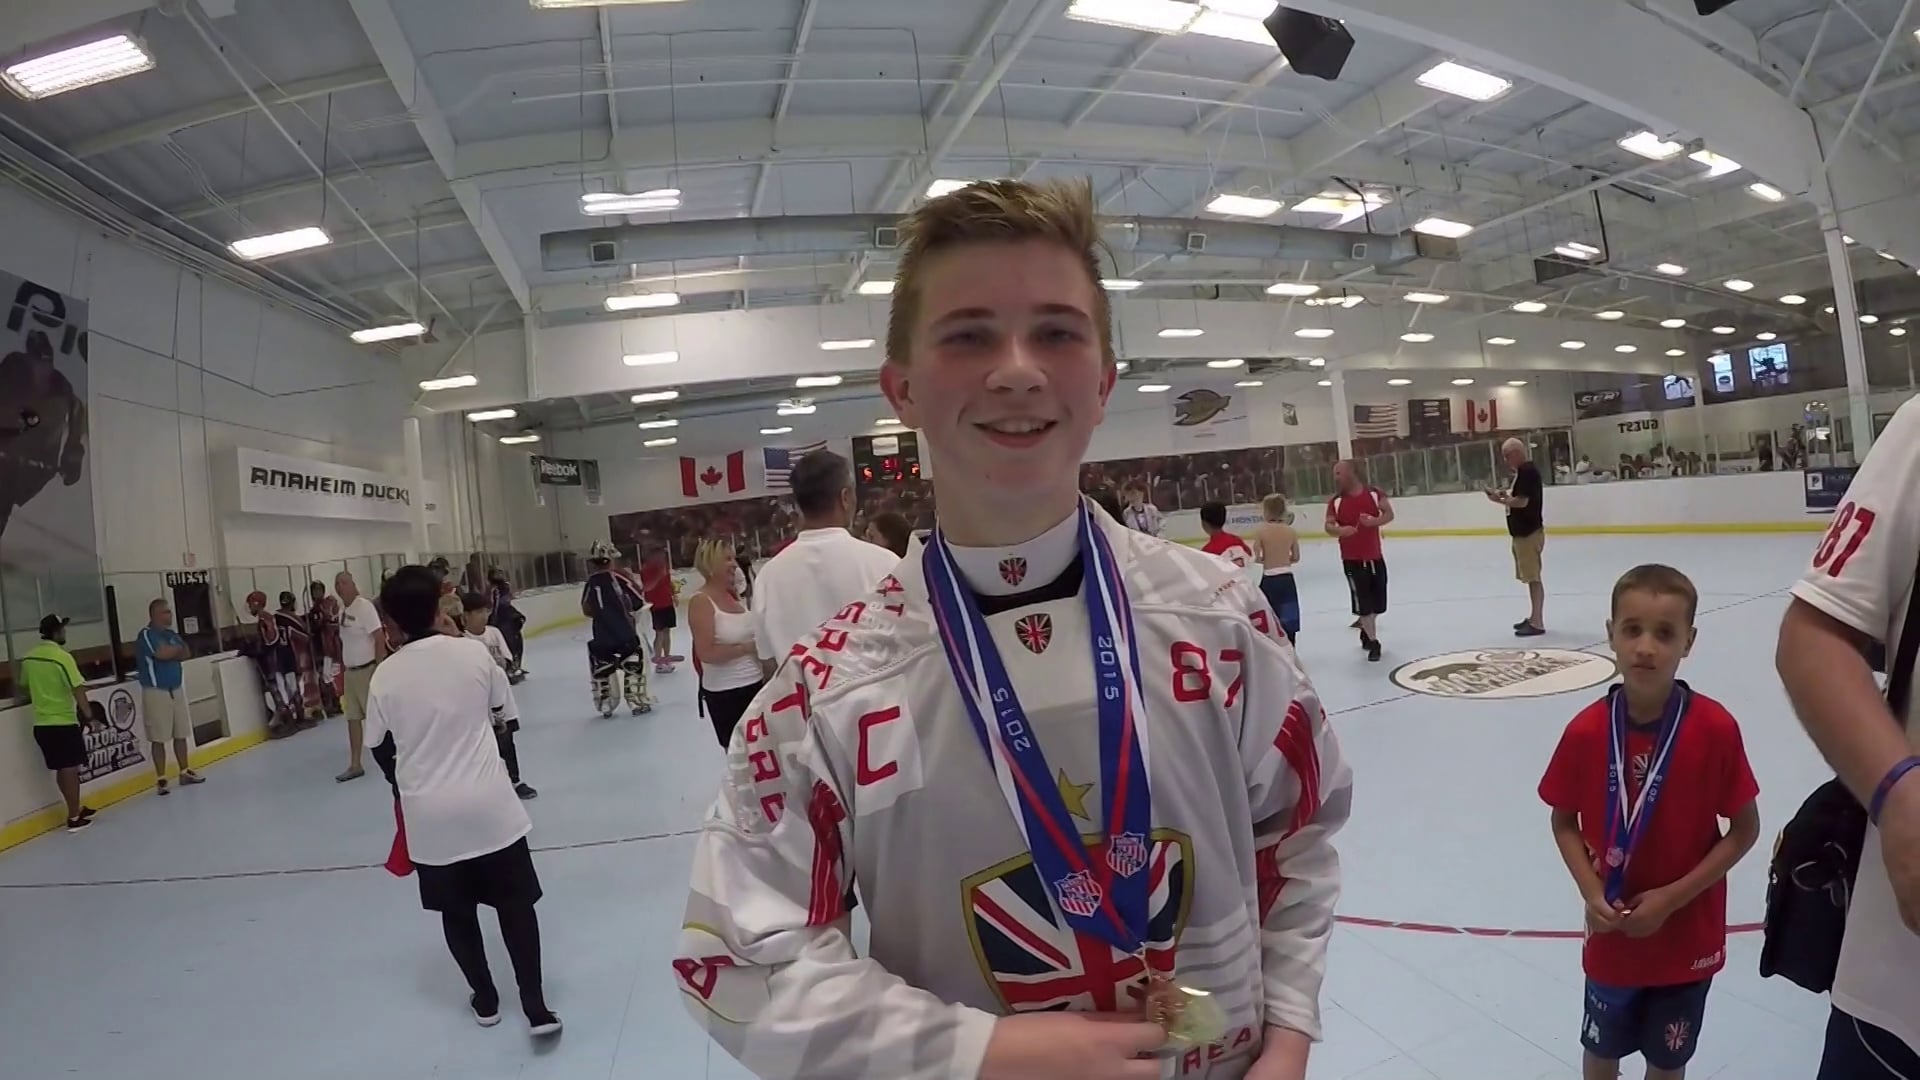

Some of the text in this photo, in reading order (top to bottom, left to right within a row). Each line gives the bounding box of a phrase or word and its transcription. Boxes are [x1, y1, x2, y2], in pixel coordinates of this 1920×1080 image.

[250, 466, 356, 497] ANAHEIM
[541, 459, 578, 476] Reebok
[1813, 501, 1876, 578] 87
[166, 571, 209, 588] GUEST
[1097, 635, 1120, 701] 2015
[1170, 640, 1244, 709] 87
[857, 705, 901, 786] C
[992, 687, 1032, 753] 2015
